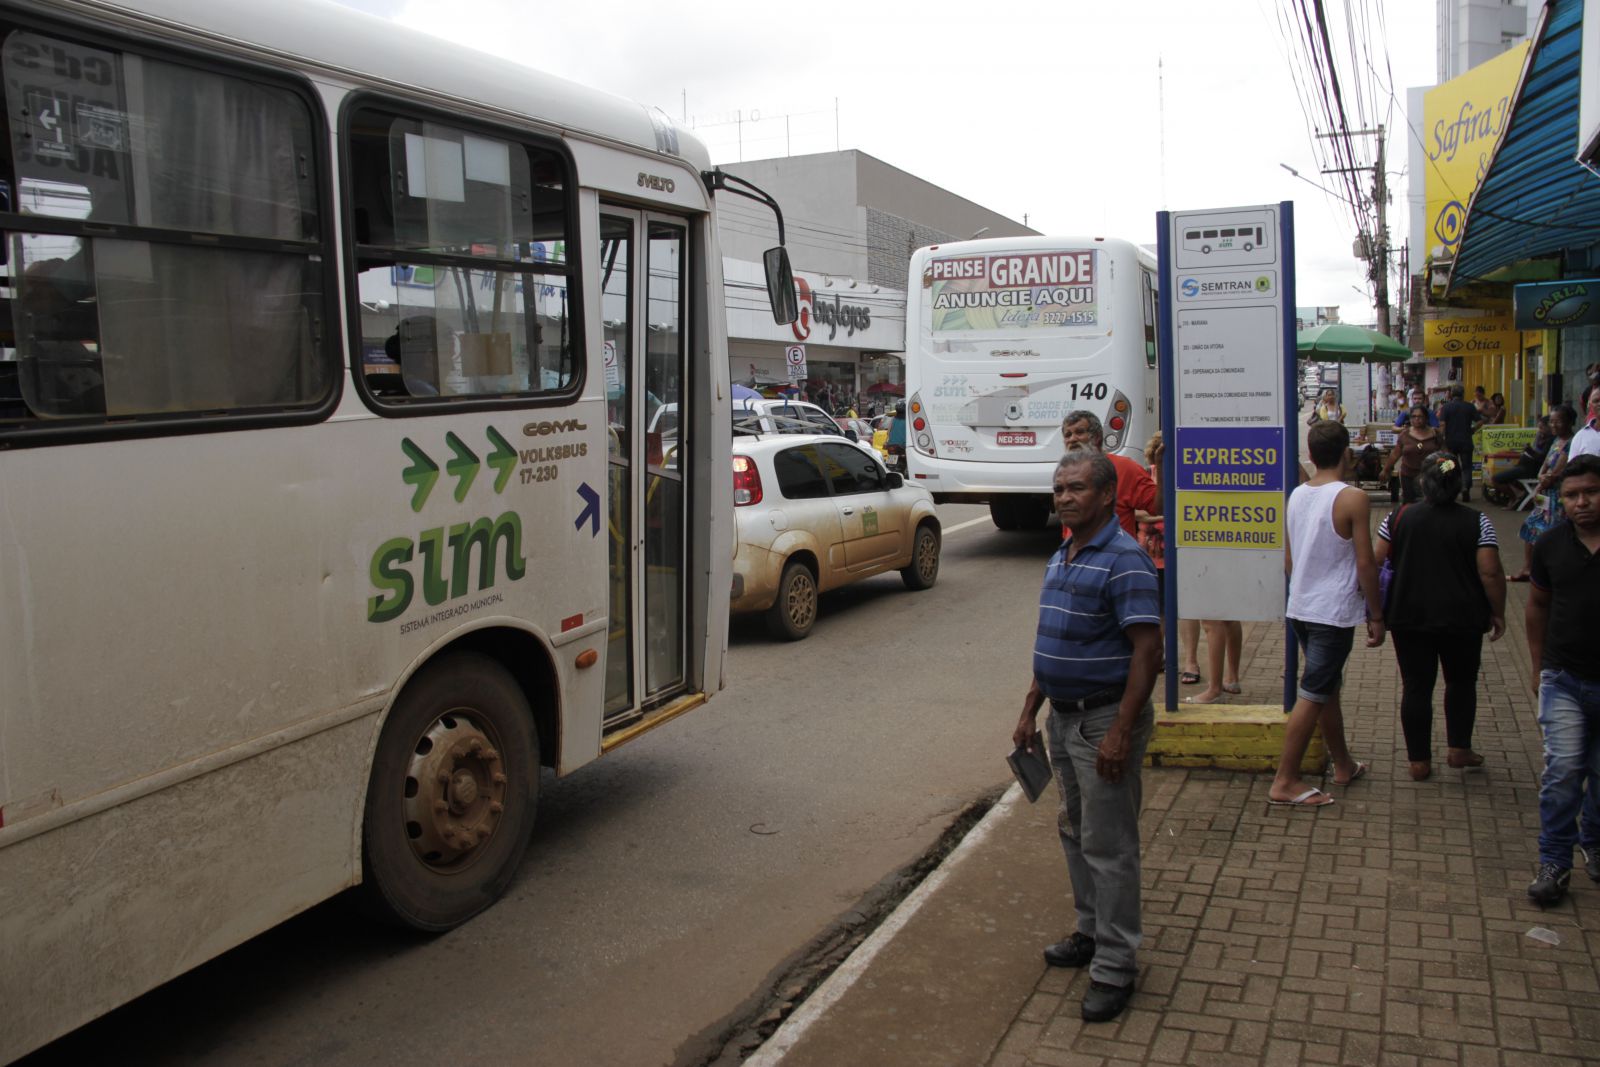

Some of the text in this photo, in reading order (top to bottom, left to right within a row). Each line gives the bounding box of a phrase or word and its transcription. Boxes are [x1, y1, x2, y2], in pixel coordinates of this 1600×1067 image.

[1430, 101, 1492, 162] Safira
[636, 172, 676, 193] SVELTO
[933, 259, 983, 279] PENSE
[991, 253, 1091, 287] GRANDE
[1201, 281, 1252, 292] SEMTRAN
[933, 287, 1094, 310] ANUNCIE AQUI
[1534, 284, 1588, 320] CARLA
[1043, 311, 1095, 325] 3227-1515
[1434, 321, 1470, 337] Safira
[1466, 335, 1501, 351] Ótica
[1069, 382, 1108, 401] 140
[1028, 400, 1077, 410] CIDADE DE
[1028, 410, 1058, 420] PORTO
[523, 419, 587, 437] COMIL
[519, 443, 587, 465] VOLKSBUS
[1183, 448, 1277, 465] EXPRESSO
[519, 465, 558, 485] 17-230
[1193, 472, 1266, 486] EMBARQUE
[1183, 505, 1277, 523] EXPRESSO
[1183, 530, 1276, 544] DESEMBARQUE
[367, 510, 527, 623] sim
[400, 593, 504, 635] SISTEMA INTEGRADO MUNICIPAL
